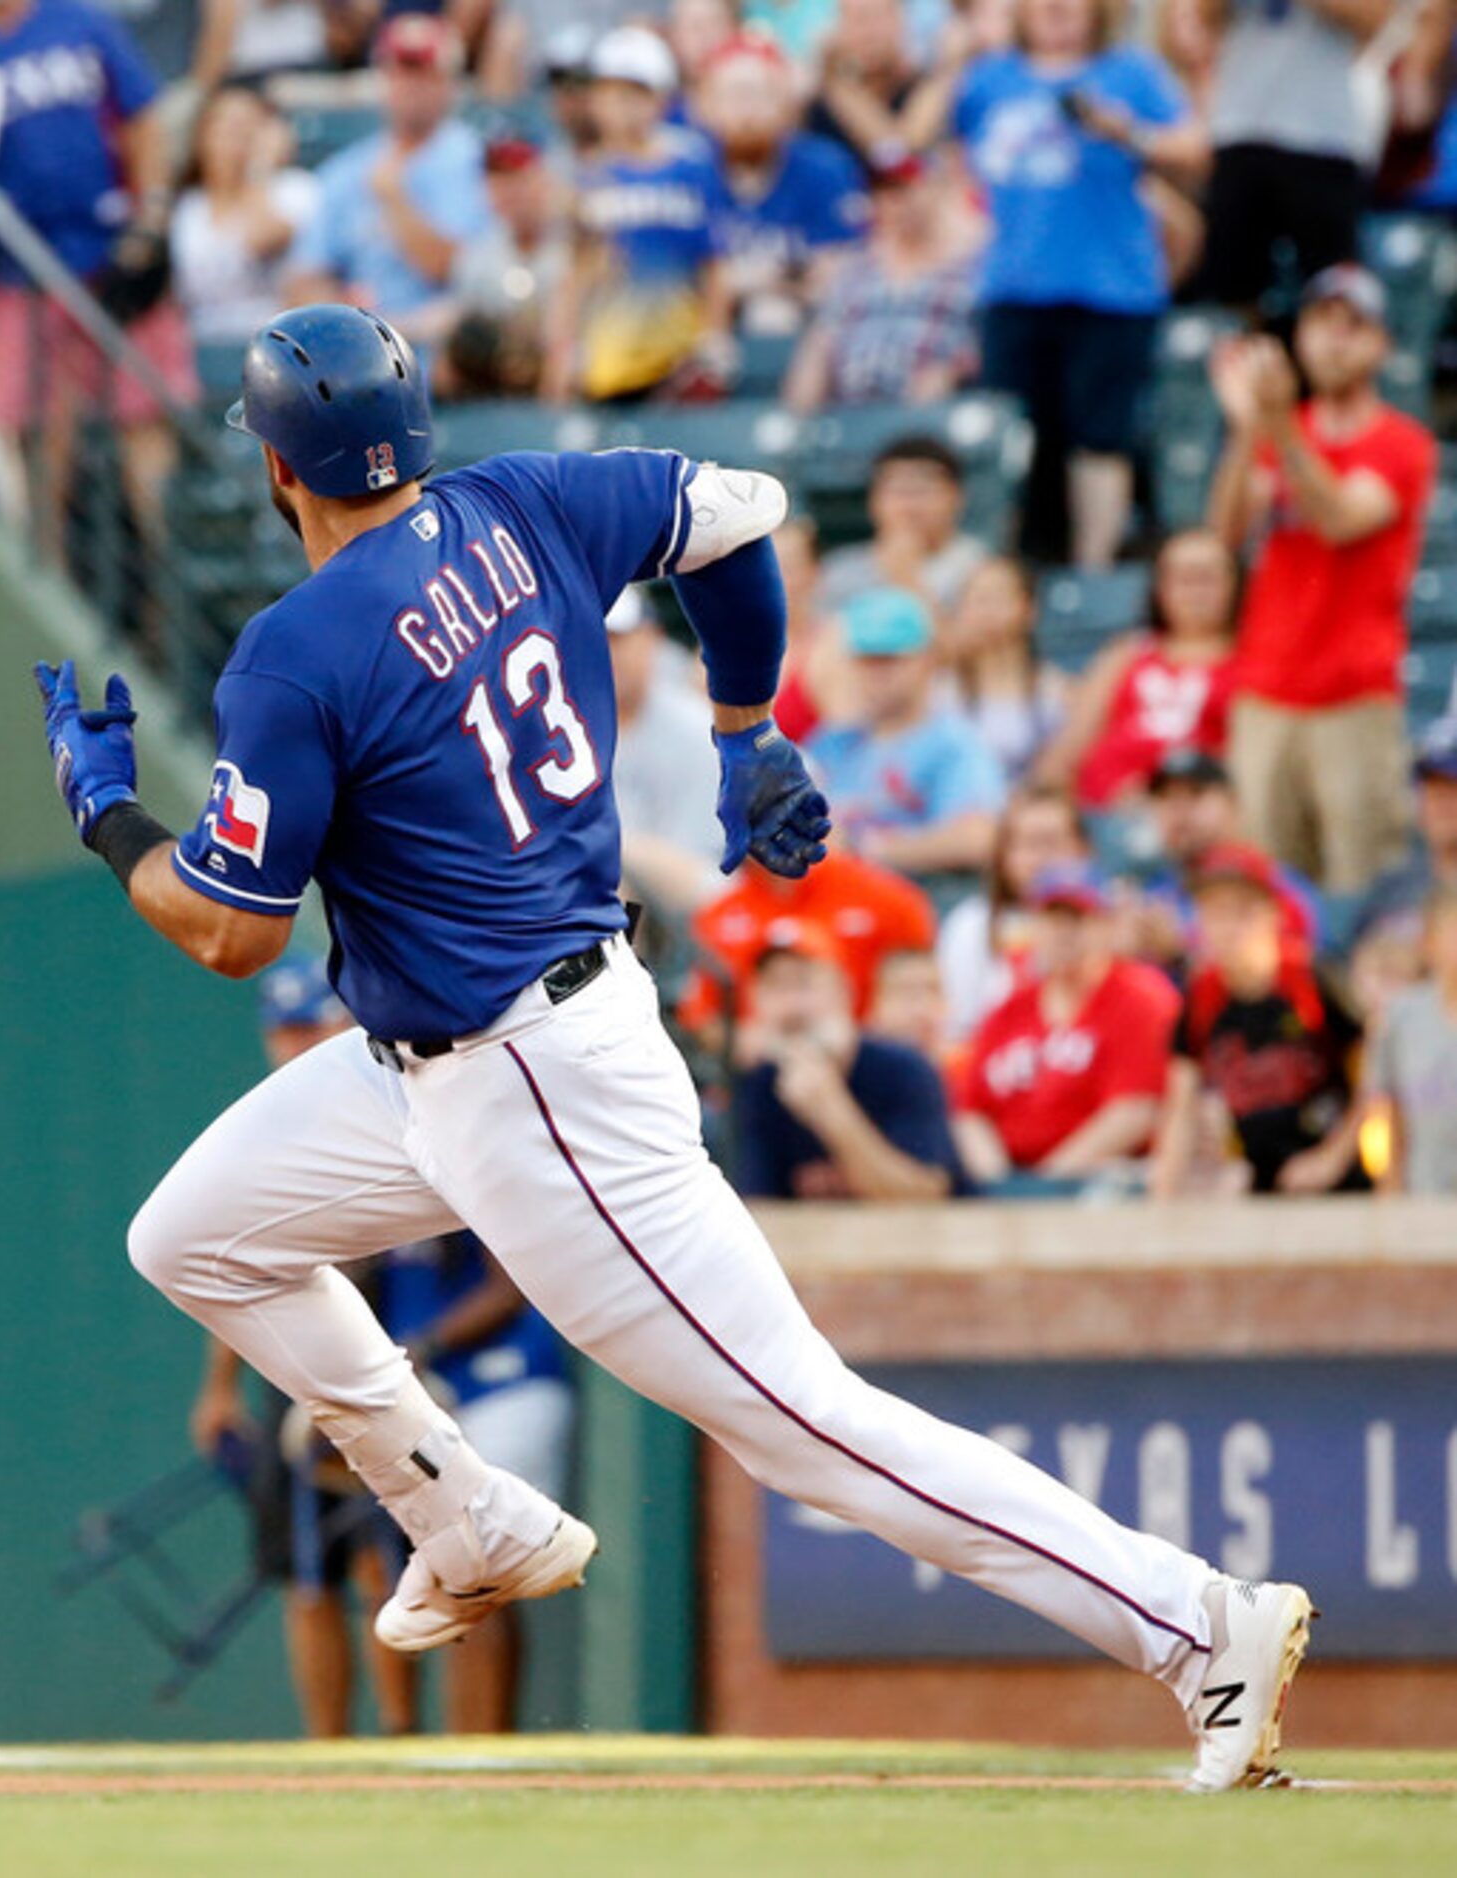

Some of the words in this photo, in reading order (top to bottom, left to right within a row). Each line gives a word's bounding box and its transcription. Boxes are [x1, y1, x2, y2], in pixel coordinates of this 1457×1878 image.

[366, 443, 395, 469] 13
[397, 526, 537, 681] GALLO
[459, 626, 603, 854] 13
[915, 1420, 1273, 1592] XAS
[1367, 1420, 1457, 1589] L
[1202, 1682, 1246, 1730] N
